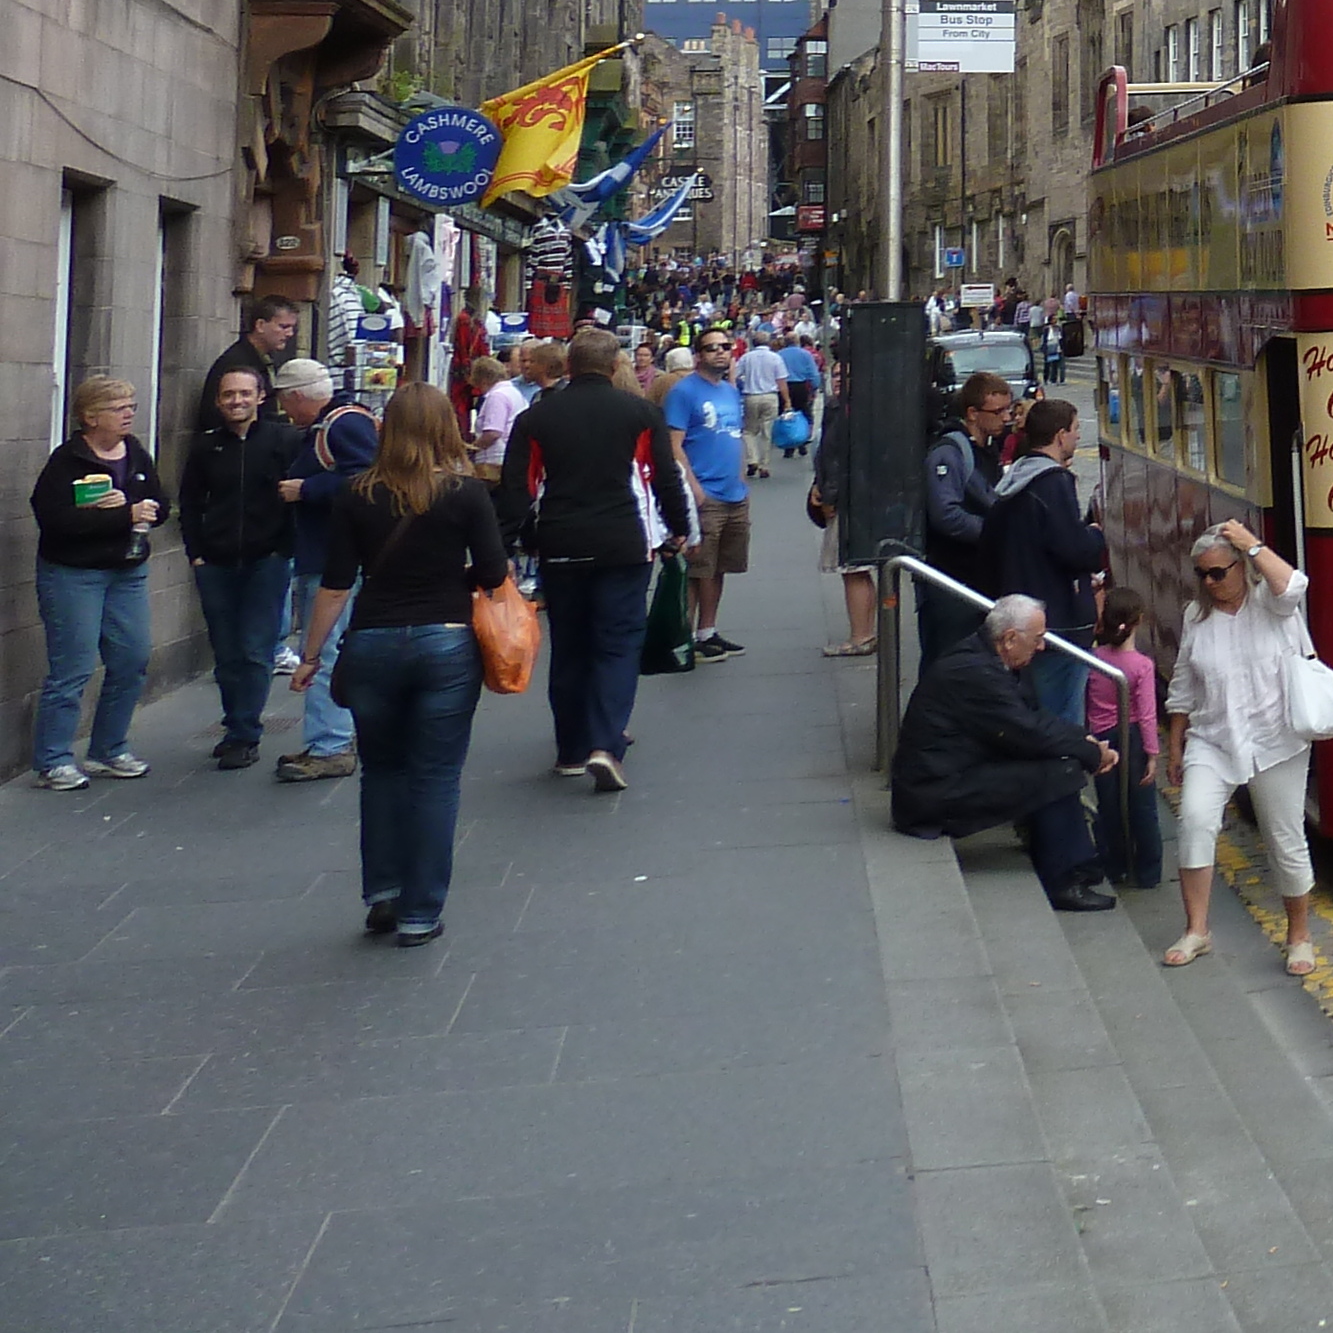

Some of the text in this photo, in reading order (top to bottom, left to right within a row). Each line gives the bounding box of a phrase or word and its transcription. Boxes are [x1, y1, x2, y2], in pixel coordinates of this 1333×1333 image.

[936, 2, 997, 11] Lawnmarket
[940, 15, 993, 26] Bus Stop
[943, 30, 990, 39] From City
[405, 113, 495, 145] CASHMERE
[401, 167, 494, 199] LAMBSWOOL
[655, 188, 713, 198] ANTUES
